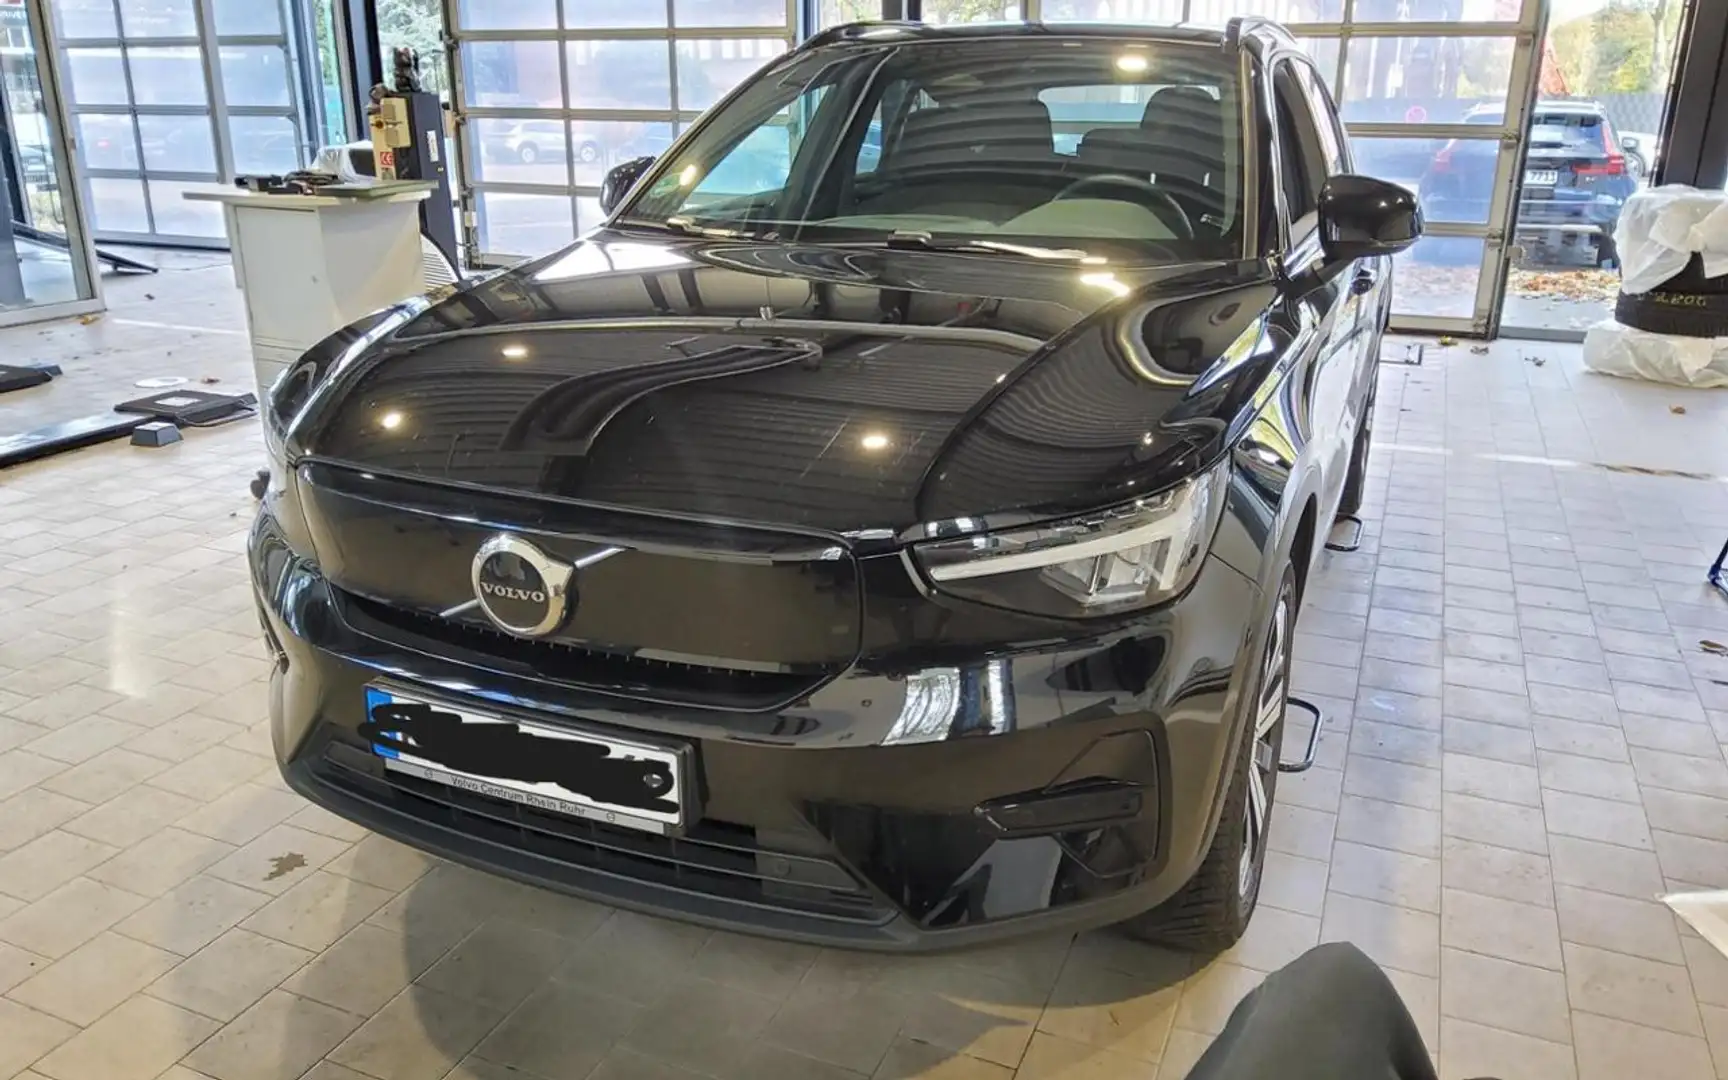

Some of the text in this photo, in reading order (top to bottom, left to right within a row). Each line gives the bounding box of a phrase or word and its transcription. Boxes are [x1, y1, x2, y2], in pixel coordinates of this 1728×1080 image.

[480, 582, 545, 602] VOLVO
[451, 775, 586, 815] Volvo Centrum Rhein Ruhr
